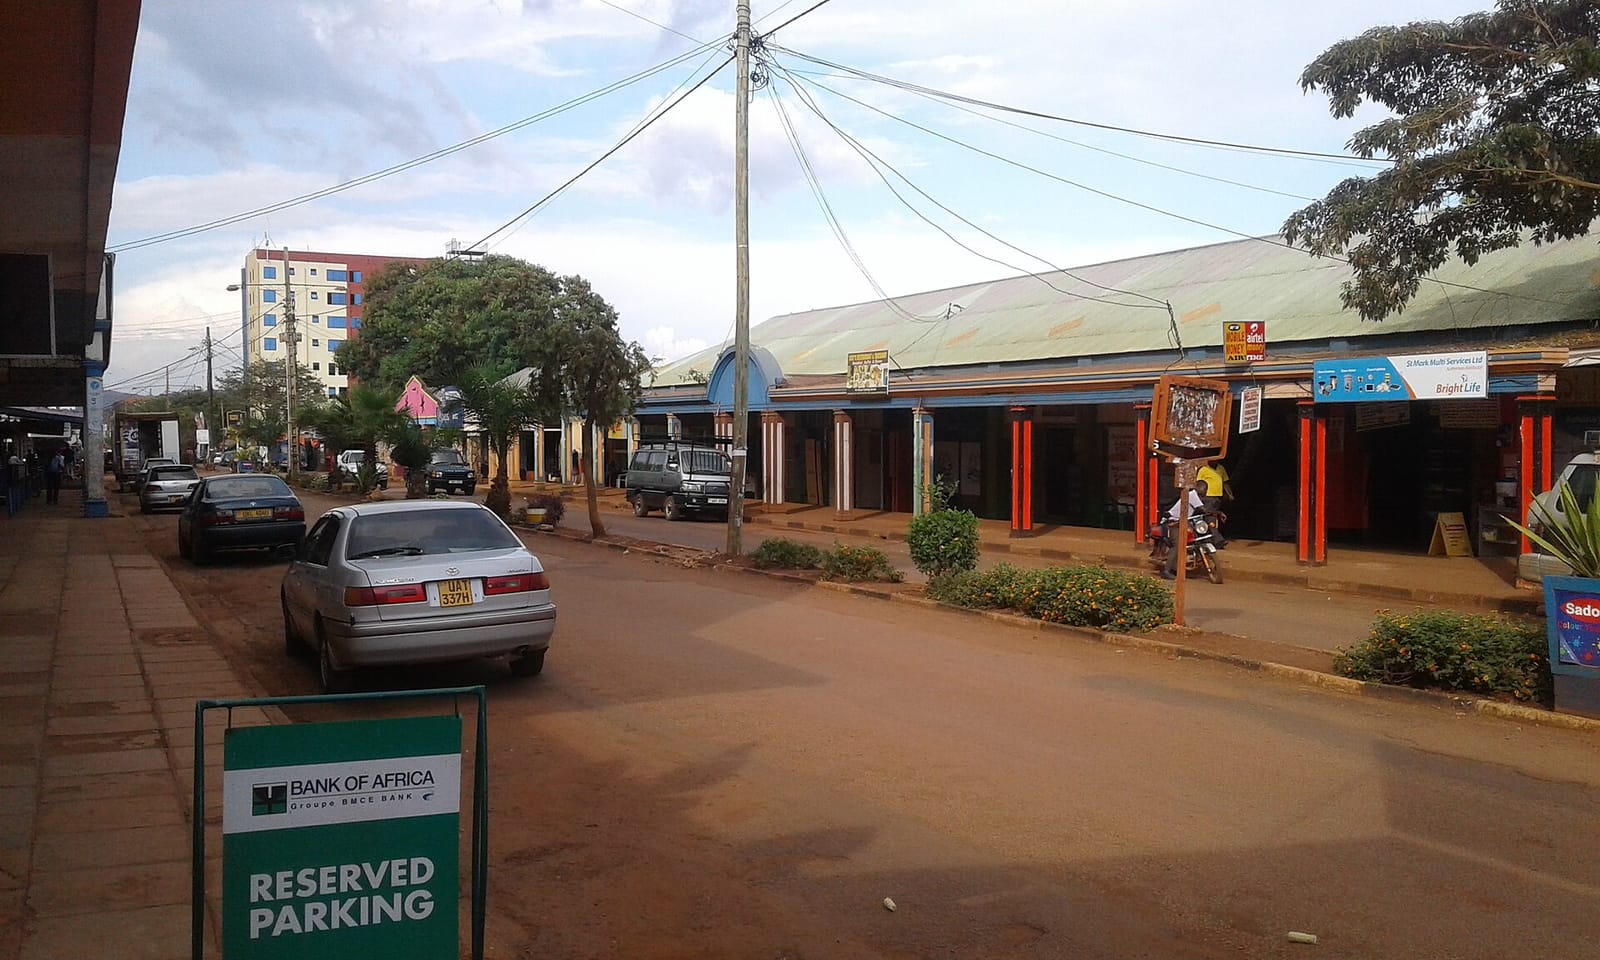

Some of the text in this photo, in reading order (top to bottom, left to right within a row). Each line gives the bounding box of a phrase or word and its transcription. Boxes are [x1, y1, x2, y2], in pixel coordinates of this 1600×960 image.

[1247, 333, 1264, 343] airtel
[1446, 357, 1471, 365] Services
[1472, 356, 1483, 364] Ltd
[1436, 382, 1481, 395] Bright Life
[448, 580, 469, 593] UAT
[442, 592, 470, 605] 337H
[1566, 603, 1600, 618] Sado
[290, 770, 435, 796] BANK OF AFRICA
[290, 792, 413, 811] Groupe BMCE BANK
[250, 856, 435, 903] RESERVED
[250, 889, 435, 940] PARKING
